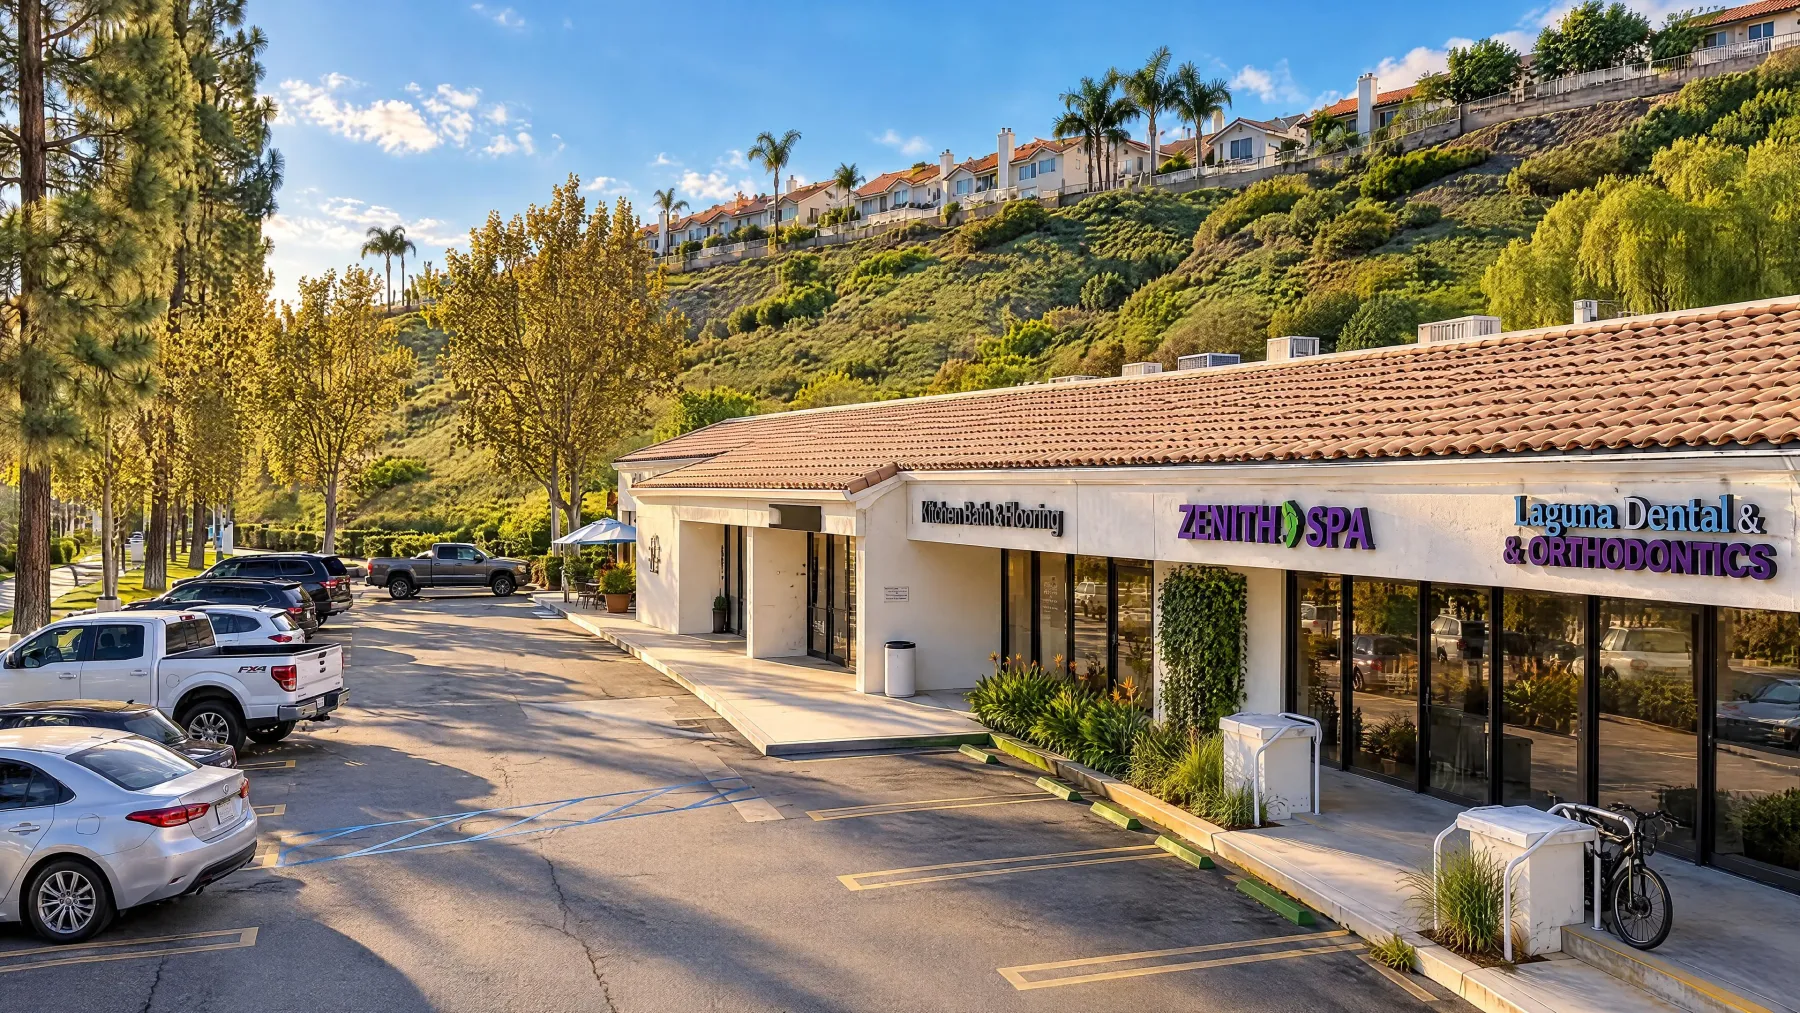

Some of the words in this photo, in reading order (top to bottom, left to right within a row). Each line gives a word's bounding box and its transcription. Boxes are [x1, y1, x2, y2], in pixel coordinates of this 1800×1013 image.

[921, 500, 964, 525] Kitchen
[963, 502, 994, 526] Bath
[993, 504, 1004, 527] &
[1004, 501, 1064, 537] Flooring
[1178, 504, 1283, 545] ZENITH
[1305, 506, 1376, 550] SPA
[1514, 495, 1620, 537] Laguna
[1624, 494, 1736, 533] Dental
[1737, 504, 1767, 534] &
[1503, 535, 1527, 565] &
[1528, 536, 1778, 580] ORTHODONTICS
[237, 665, 267, 673] FX4
